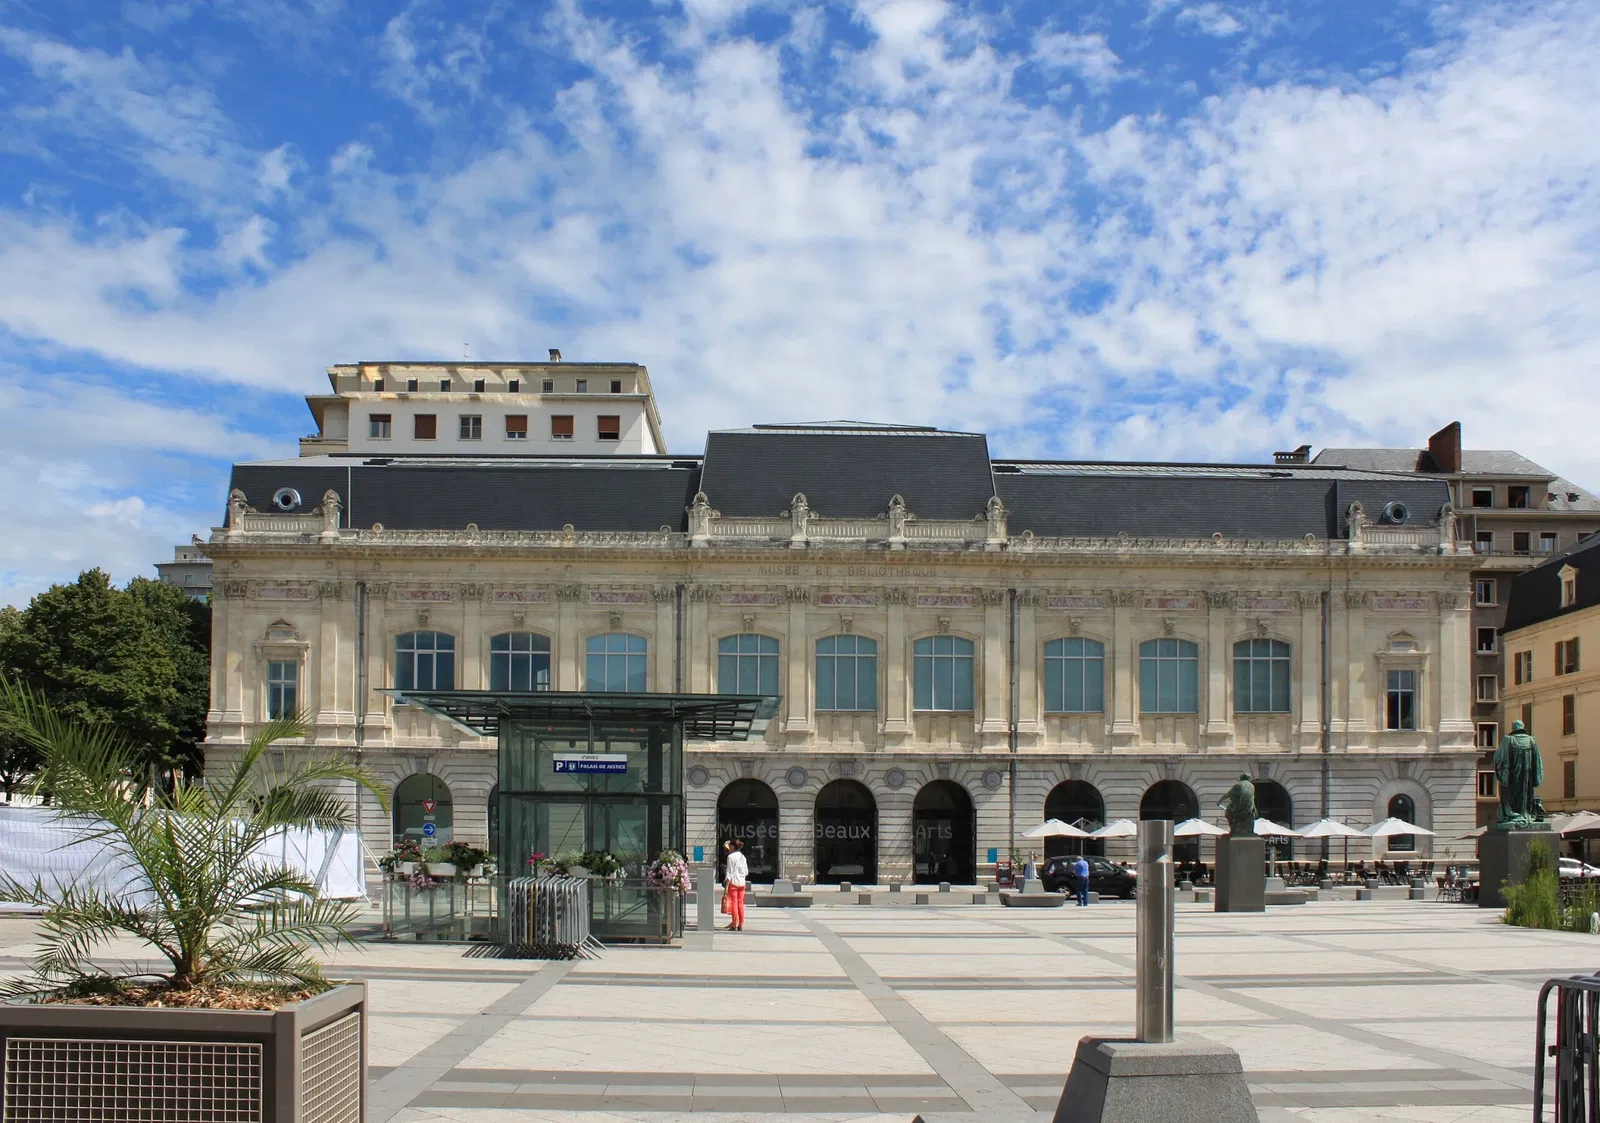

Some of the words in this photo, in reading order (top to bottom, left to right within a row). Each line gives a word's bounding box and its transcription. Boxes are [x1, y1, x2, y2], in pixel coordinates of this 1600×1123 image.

[815, 567, 832, 576] ET
[556, 762, 563, 771] P
[719, 820, 777, 838] Musée
[916, 823, 953, 839] Arts
